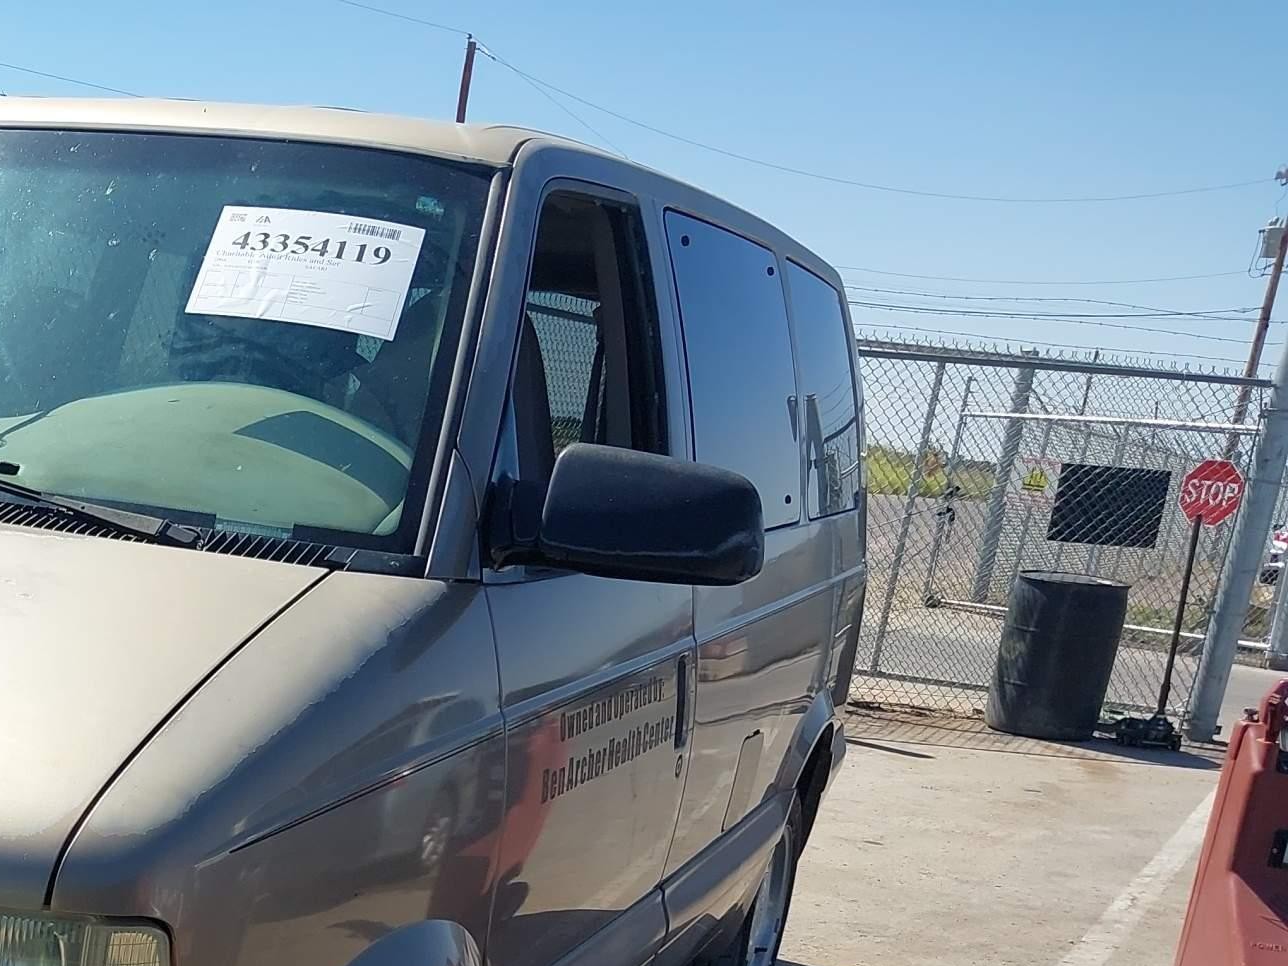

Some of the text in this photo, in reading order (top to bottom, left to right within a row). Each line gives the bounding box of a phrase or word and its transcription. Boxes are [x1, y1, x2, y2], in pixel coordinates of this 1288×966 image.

[231, 231, 392, 266] 43354119
[1185, 479, 1239, 507] STOP
[559, 703, 594, 742] Owned
[595, 696, 612, 727] and
[613, 681, 652, 720] operated
[540, 715, 675, 804] Ben Archer Health Center
